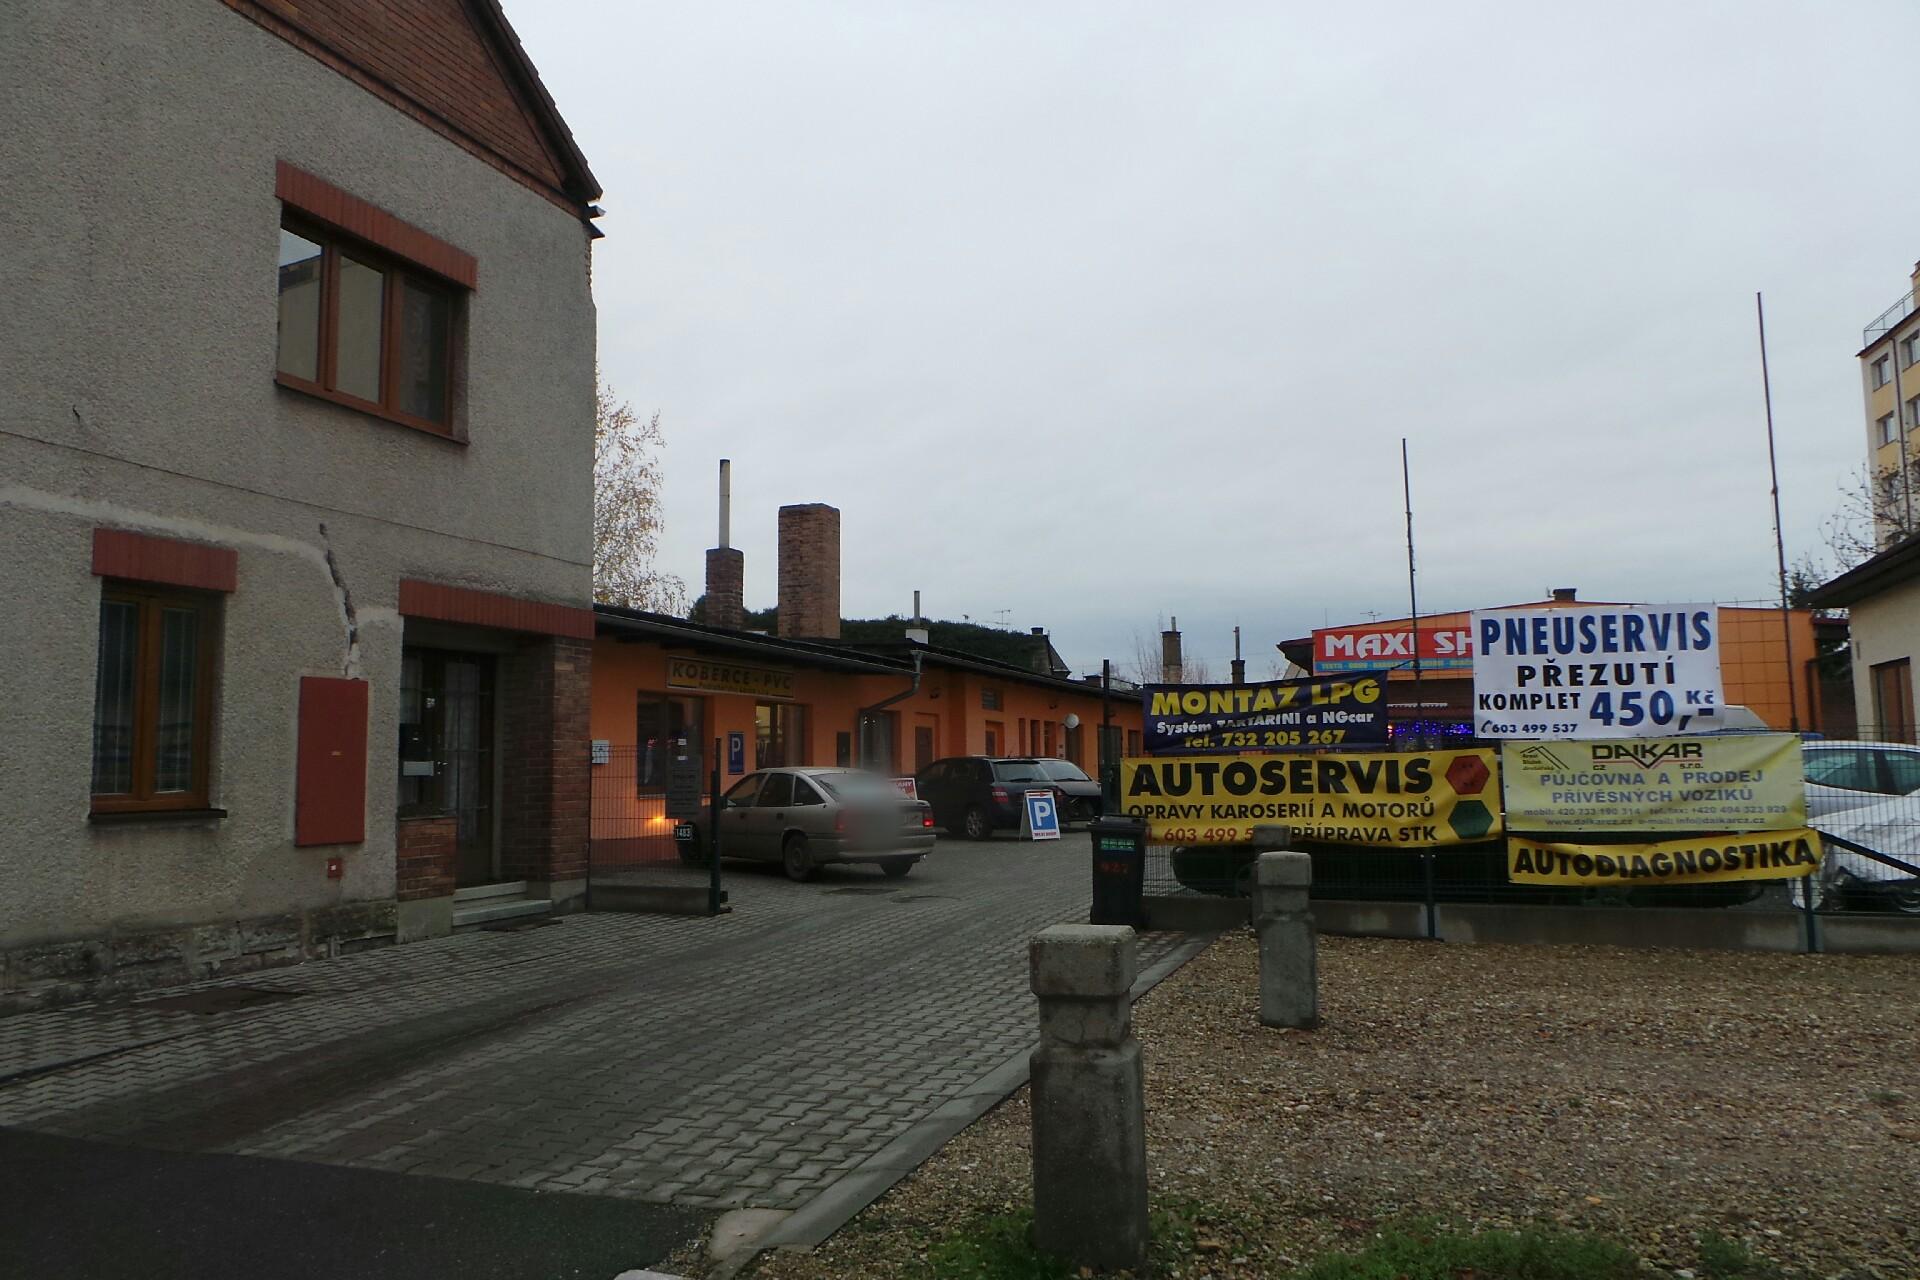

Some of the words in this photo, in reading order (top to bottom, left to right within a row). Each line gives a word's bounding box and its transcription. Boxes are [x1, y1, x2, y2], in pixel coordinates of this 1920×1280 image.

[1480, 611, 1711, 656] PNEUSERVIS
[673, 663, 751, 685] KOBERCE
[763, 674, 791, 689] PVC
[1517, 655, 1676, 688] PŘEZUTÍ
[1311, 678, 1380, 705] LPG
[1479, 692, 1581, 711] KOMPLET
[1686, 690, 1715, 705] Kč
[1156, 720, 1212, 736] Systém
[1306, 714, 1317, 724] a
[1322, 711, 1374, 724] NGcar
[1492, 722, 1518, 734] 603
[1521, 722, 1548, 734] 499
[1552, 721, 1578, 734] 537
[732, 738, 741, 761] P
[1222, 732, 1258, 747] 732
[1265, 731, 1301, 746] 205
[1307, 730, 1346, 745] 267
[1128, 759, 1433, 797] AUTOSERVIS
[1657, 772, 1671, 784] A
[1682, 769, 1764, 784] PRODEJ
[1034, 801, 1050, 827] P
[1129, 804, 1204, 819] OPRAVY
[1211, 799, 1315, 819] KAROSERIÍ
[1320, 803, 1336, 819] A
[1342, 797, 1435, 819] MOTORŮ
[1163, 828, 1197, 842] 603
[1204, 828, 1237, 842] 499
[1291, 823, 1391, 842] PŘÍPRAVA
[1398, 825, 1437, 842] STK
[1513, 838, 1816, 879] AUTODIAGNOSTIKA
